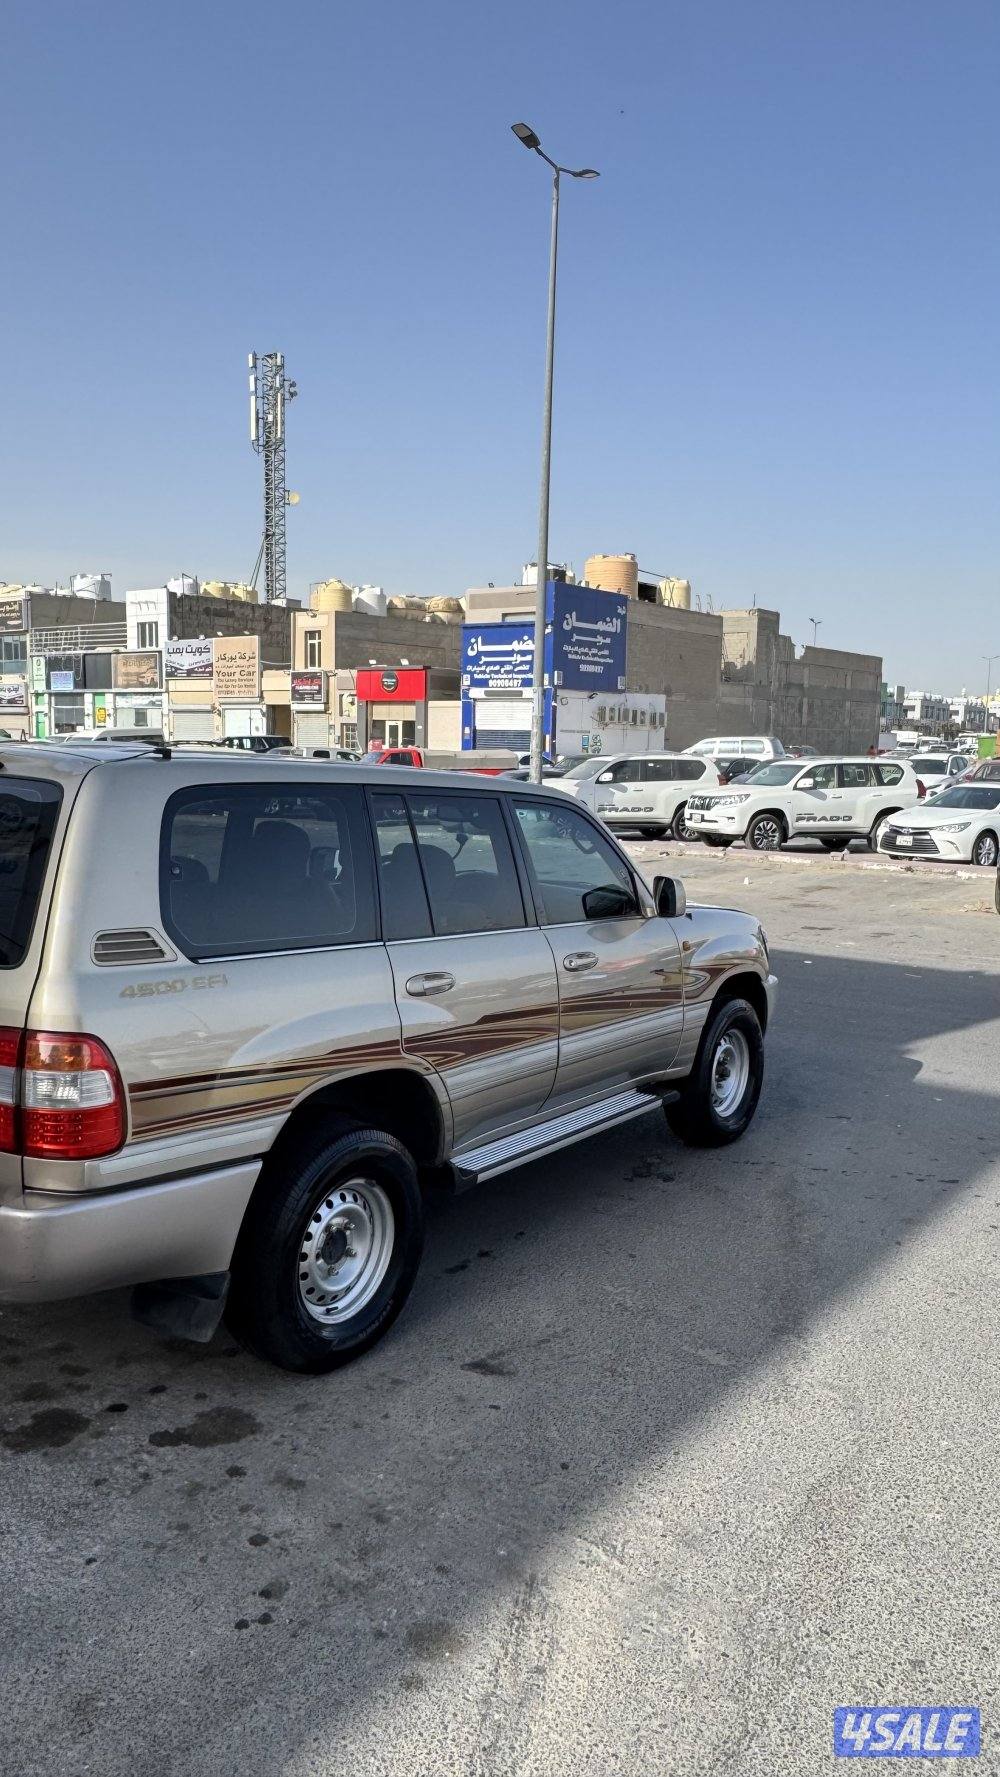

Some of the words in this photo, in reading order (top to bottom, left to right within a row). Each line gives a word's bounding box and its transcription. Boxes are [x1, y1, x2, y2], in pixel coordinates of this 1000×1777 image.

[562, 611, 621, 633] الضمان
[167, 647, 184, 657] بمب
[185, 643, 211, 656] كويت
[467, 635, 535, 657] ضمان
[237, 651, 256, 662] شركة
[479, 653, 532, 664] سوبر
[239, 669, 257, 677] Car
[119, 979, 188, 998] 4500
[191, 974, 228, 990] EFI
